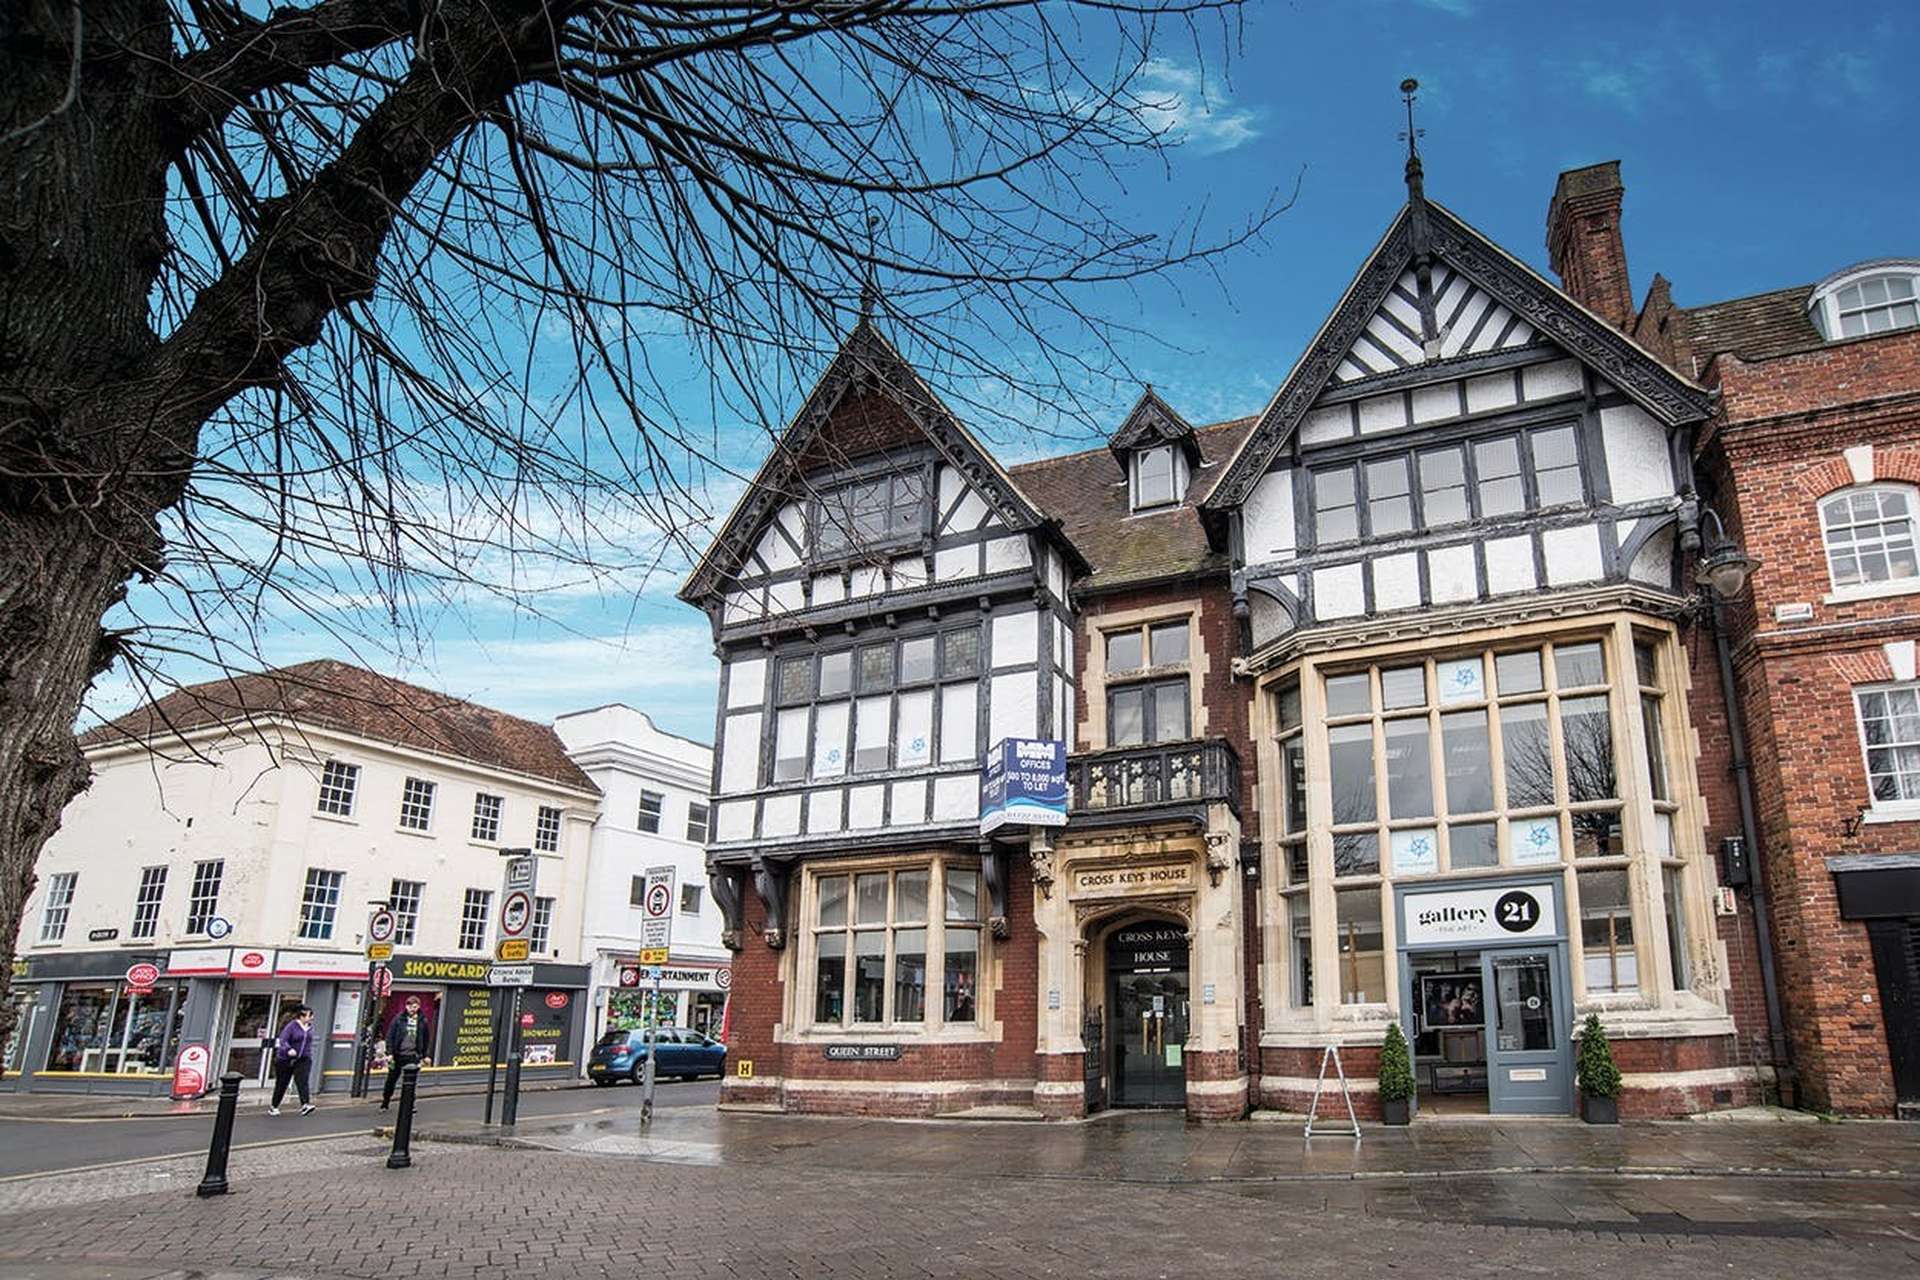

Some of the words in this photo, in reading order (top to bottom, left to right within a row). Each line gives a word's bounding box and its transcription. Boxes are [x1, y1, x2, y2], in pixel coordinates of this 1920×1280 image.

[1020, 760, 1051, 770] OFFICES
[1021, 772, 1031, 781] TO
[1024, 781, 1033, 791] TO
[1034, 782, 1048, 792] LET
[1080, 874, 1114, 886] CROSS
[1120, 872, 1145, 882] KEYS
[1151, 868, 1186, 880] HOUSE
[1418, 907, 1487, 926] gallery
[1503, 901, 1532, 922] 21
[1118, 931, 1153, 942] CROSS
[1156, 929, 1184, 940] KEYS
[1134, 951, 1171, 963] HOUSE
[829, 1047, 860, 1056] QUEEN
[864, 1047, 895, 1056] STREET
[740, 1063, 750, 1075] H
